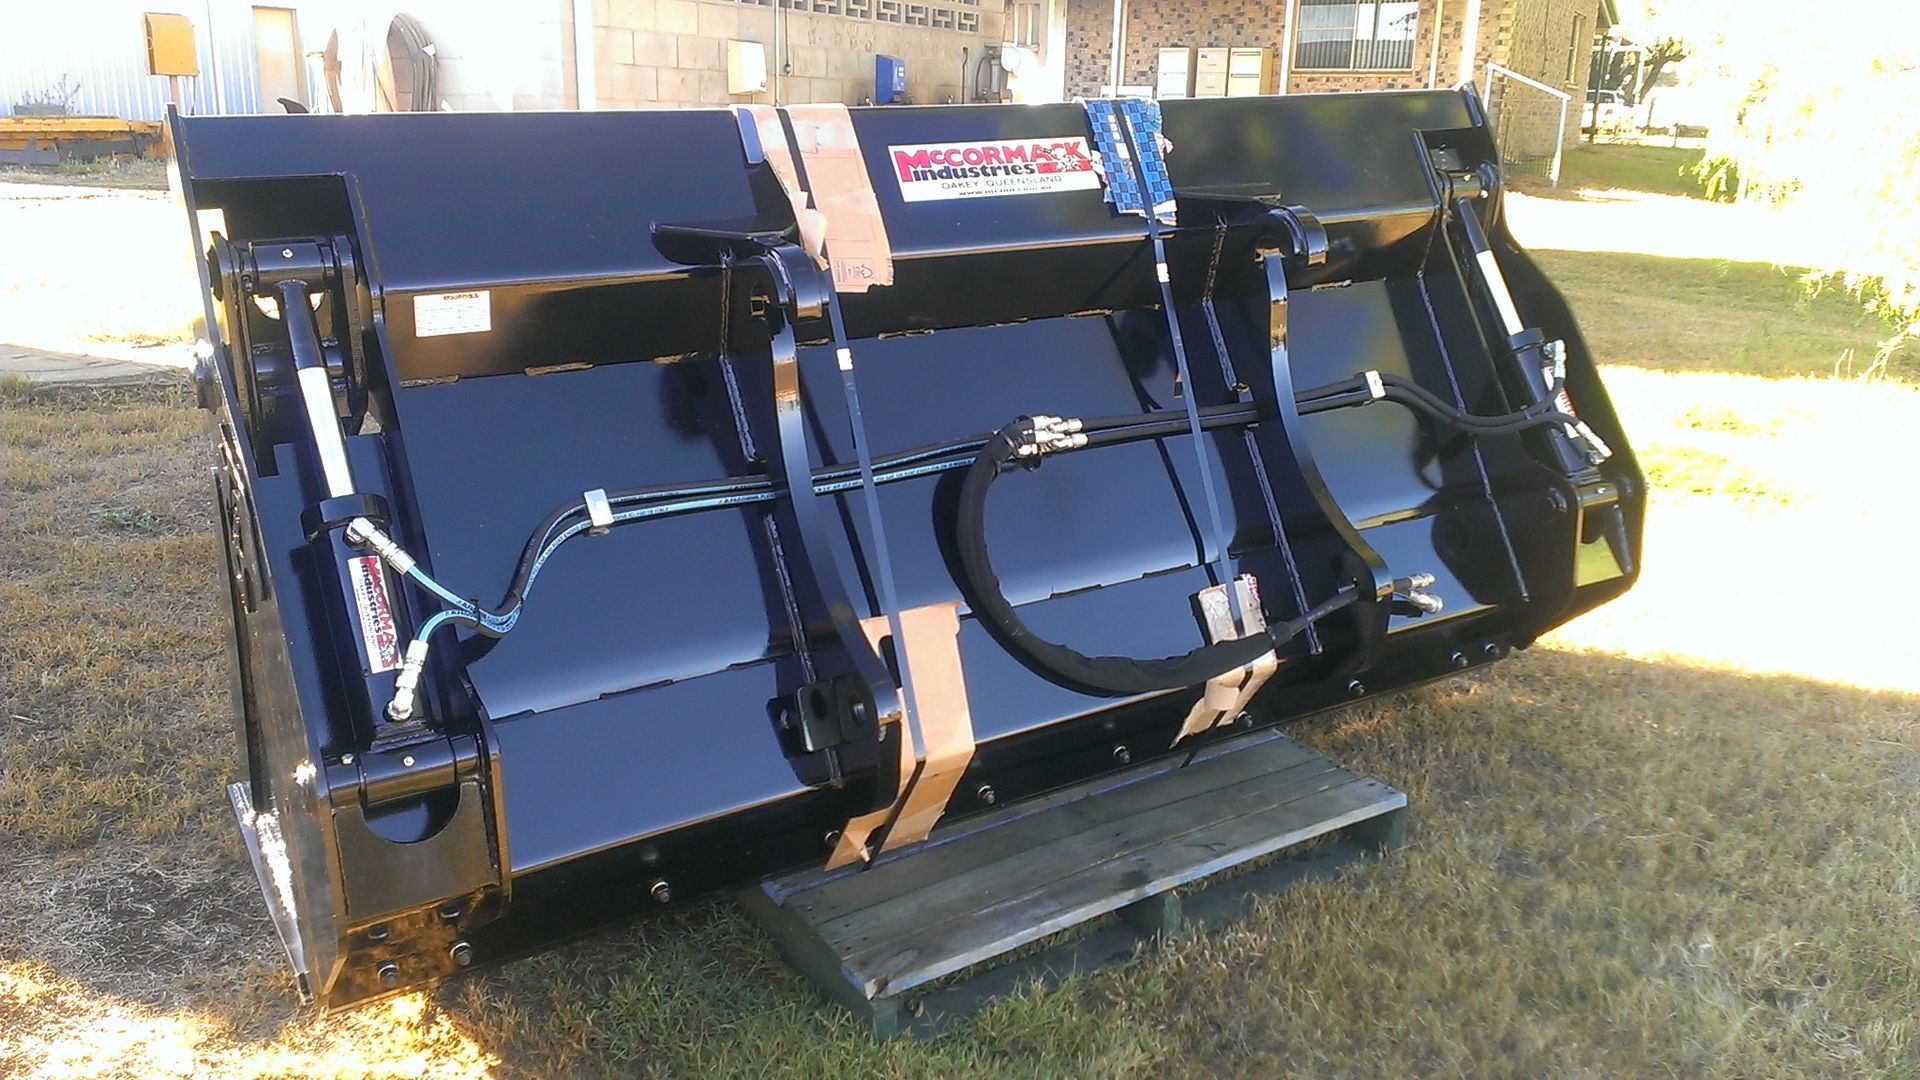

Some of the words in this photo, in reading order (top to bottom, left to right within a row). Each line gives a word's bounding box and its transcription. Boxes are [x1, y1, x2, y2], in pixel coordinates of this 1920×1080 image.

[912, 162, 1036, 182] industries
[941, 180, 979, 190] OAKEY
[986, 175, 1062, 188] QUEENSLAND
[361, 564, 383, 634] industries
